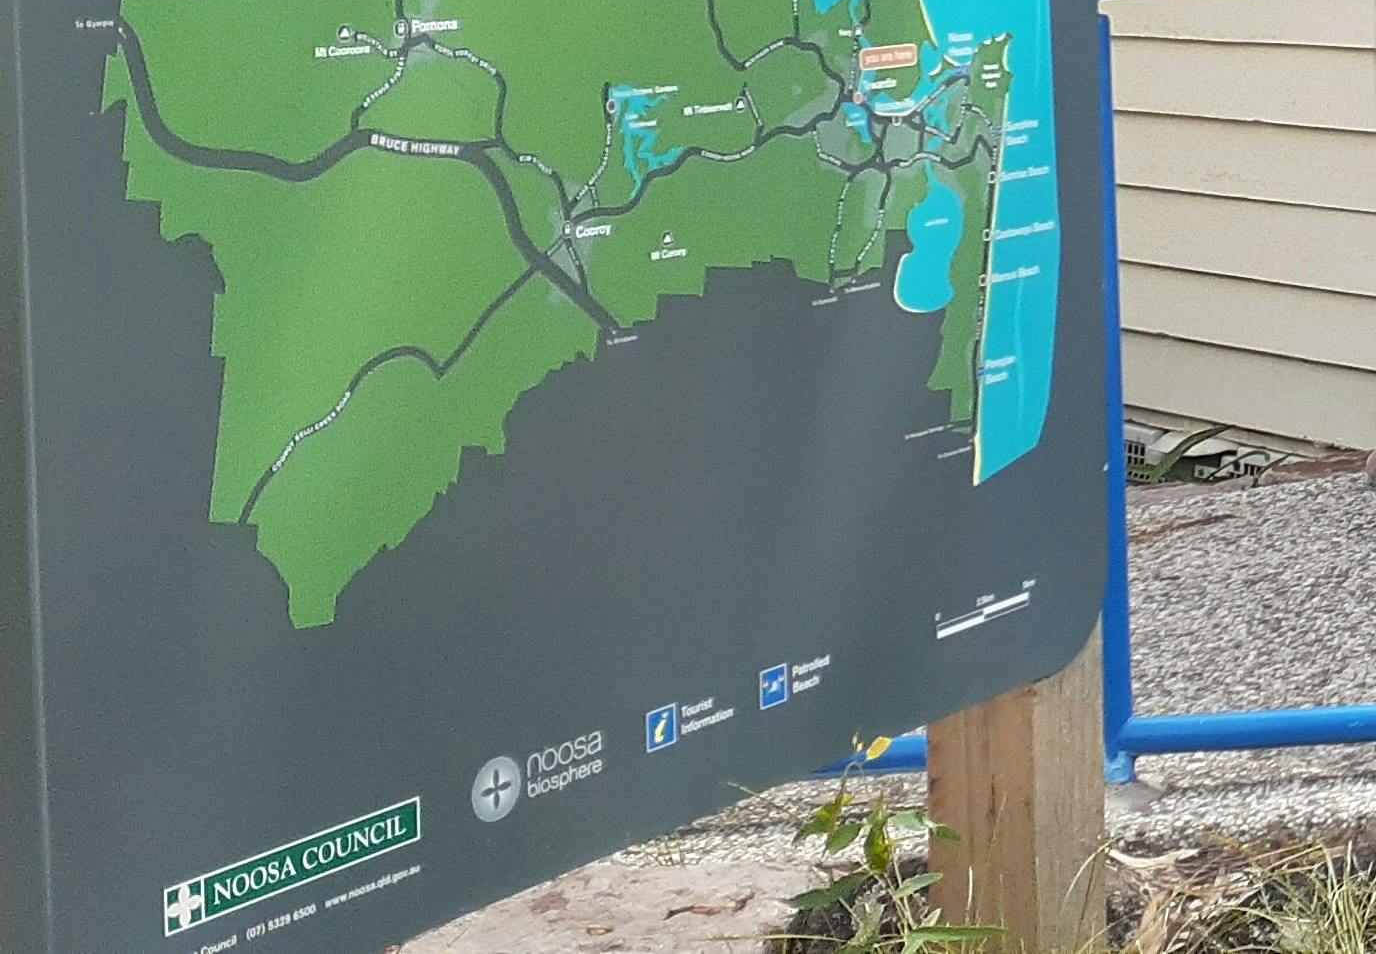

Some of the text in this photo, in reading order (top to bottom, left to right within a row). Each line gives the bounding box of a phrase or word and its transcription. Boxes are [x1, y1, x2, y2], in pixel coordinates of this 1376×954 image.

[411, 20, 458, 32] Pomona
[370, 133, 460, 156] BRUCE HIGHWAY
[792, 655, 830, 678] Patrolled
[792, 675, 820, 694] Beach
[681, 697, 713, 718] Tourist
[681, 708, 735, 735] Information
[527, 730, 603, 777] noosa
[527, 758, 603, 799] biosphere
[212, 815, 407, 905] NOOSA COUNCIL
[246, 923, 266, 942] (07)
[293, 904, 317, 922] 6500
